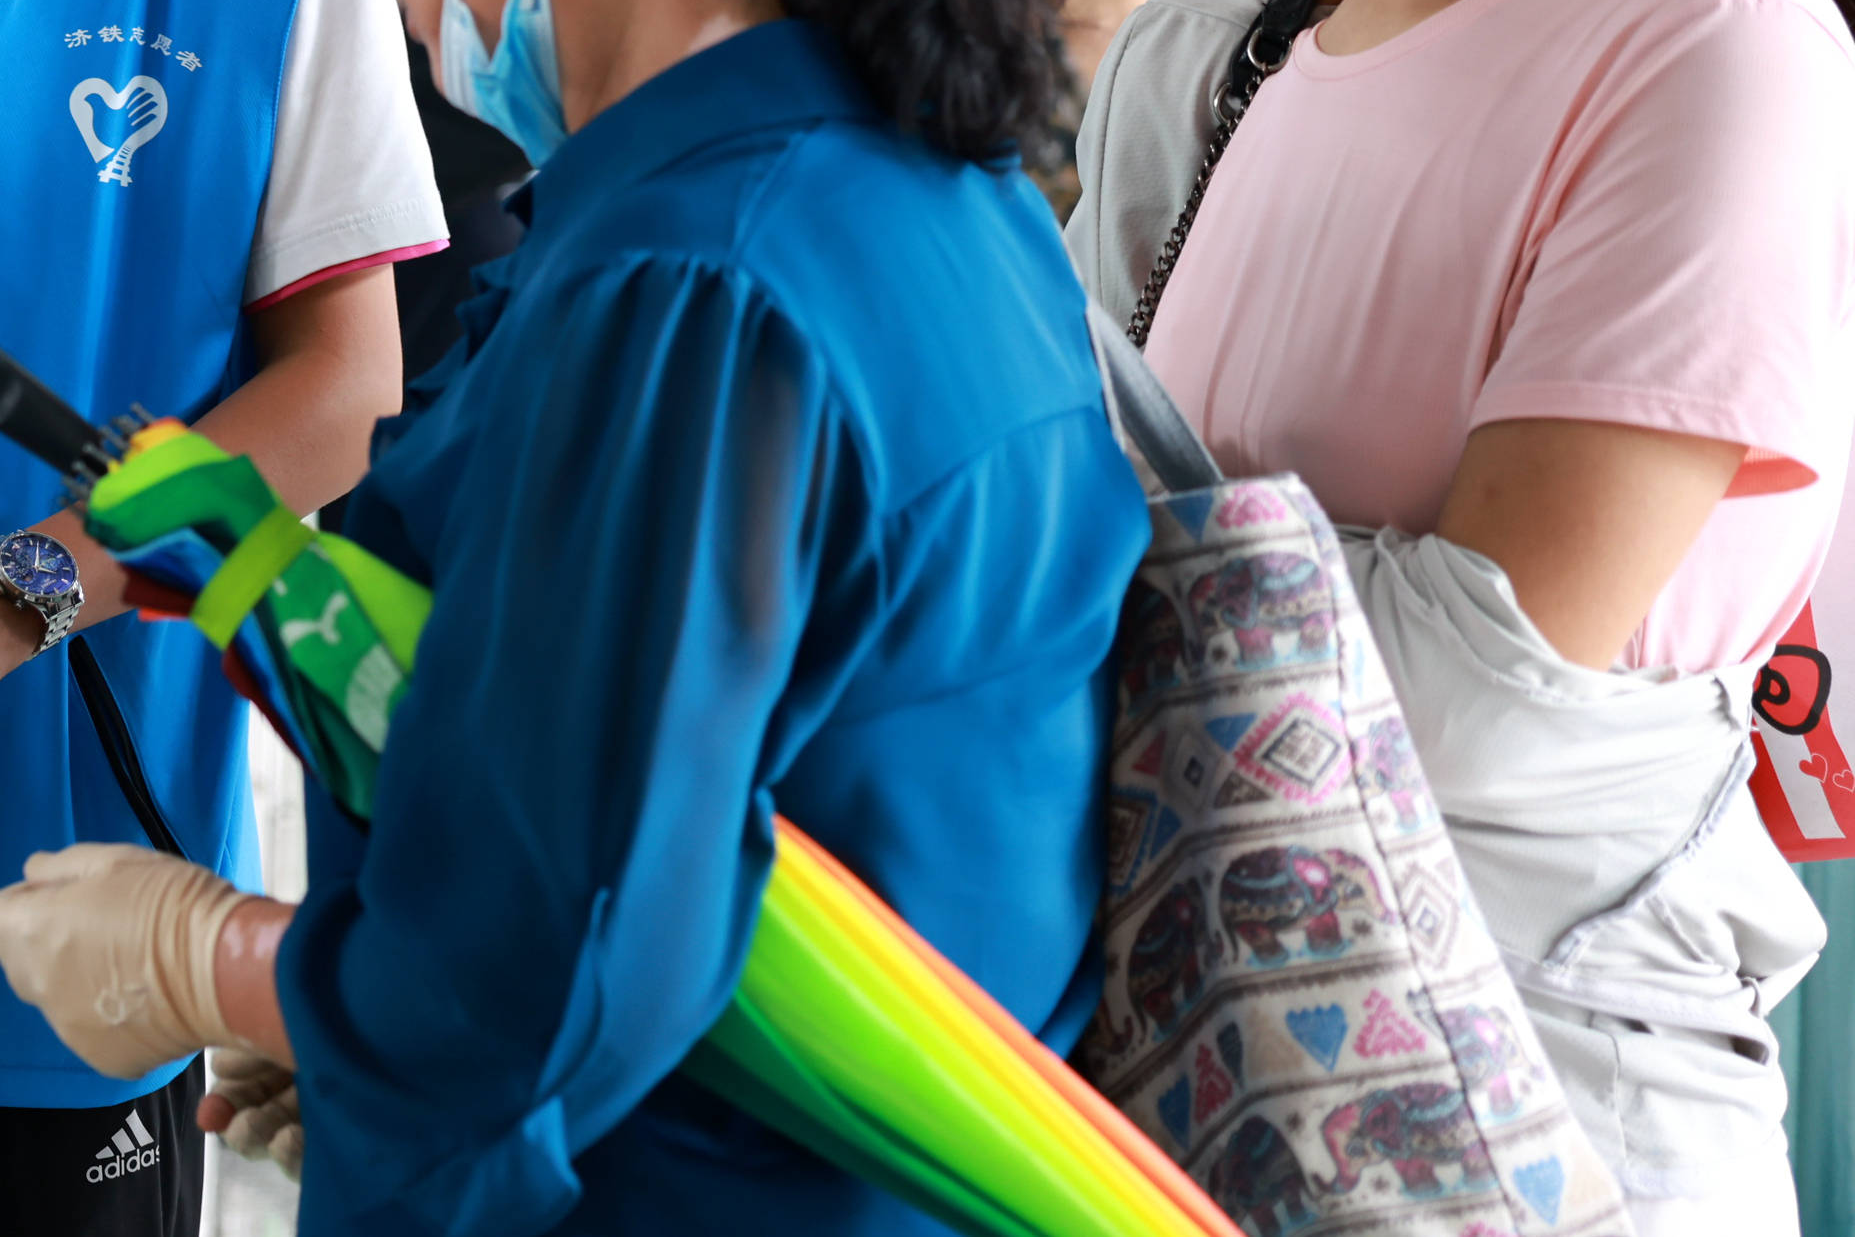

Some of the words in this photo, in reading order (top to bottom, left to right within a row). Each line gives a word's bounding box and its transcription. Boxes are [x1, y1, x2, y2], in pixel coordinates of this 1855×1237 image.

[64, 25, 203, 72] 济铁志愿者
